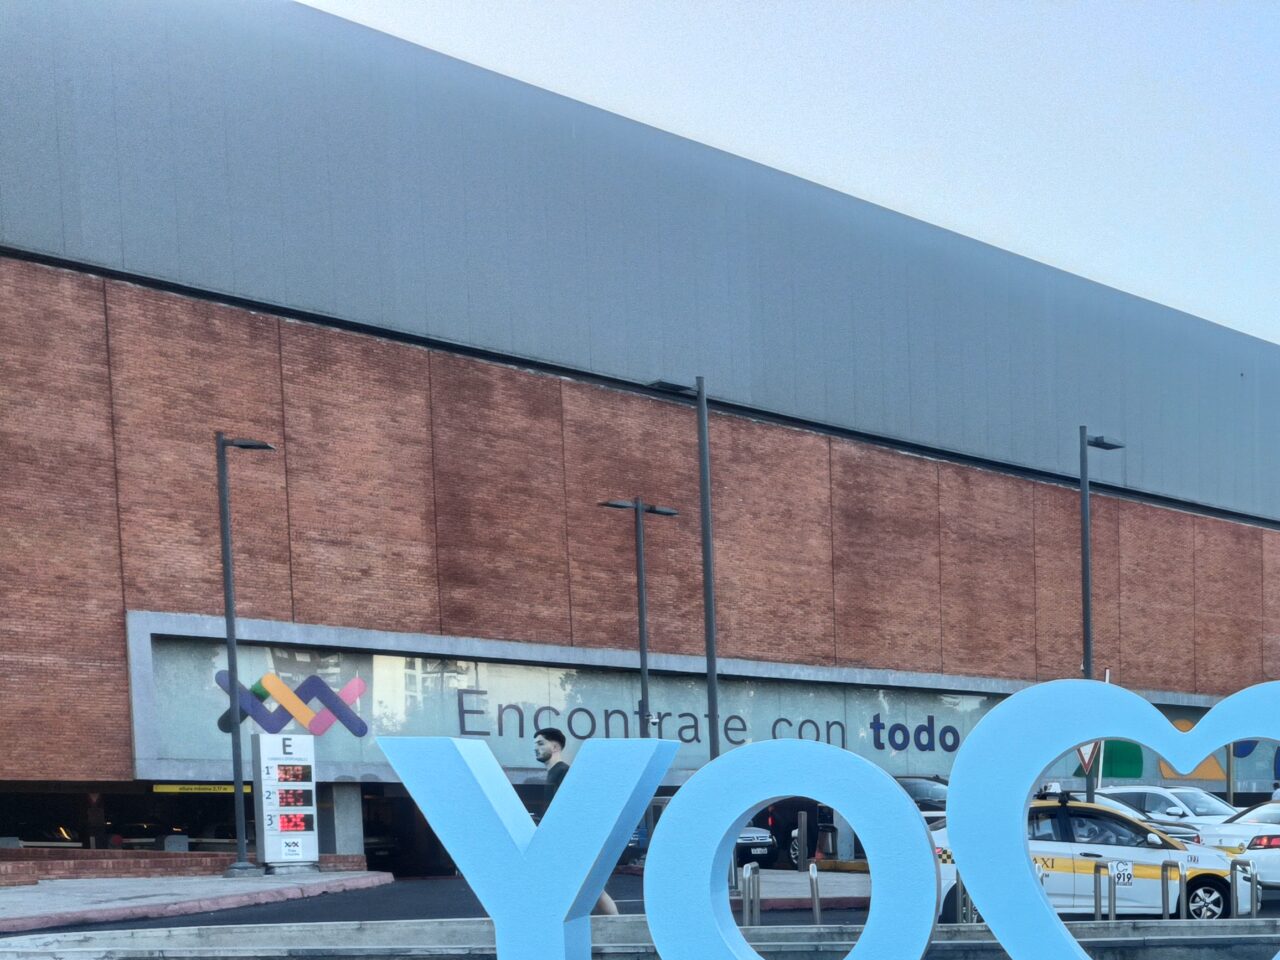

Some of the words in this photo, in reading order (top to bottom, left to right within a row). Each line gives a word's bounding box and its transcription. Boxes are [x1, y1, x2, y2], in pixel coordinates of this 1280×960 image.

[457, 688, 747, 745] Enconrae
[772, 717, 847, 750] con
[870, 713, 960, 752] todo
[282, 737, 293, 755] E
[1116, 872, 1132, 882] 919
